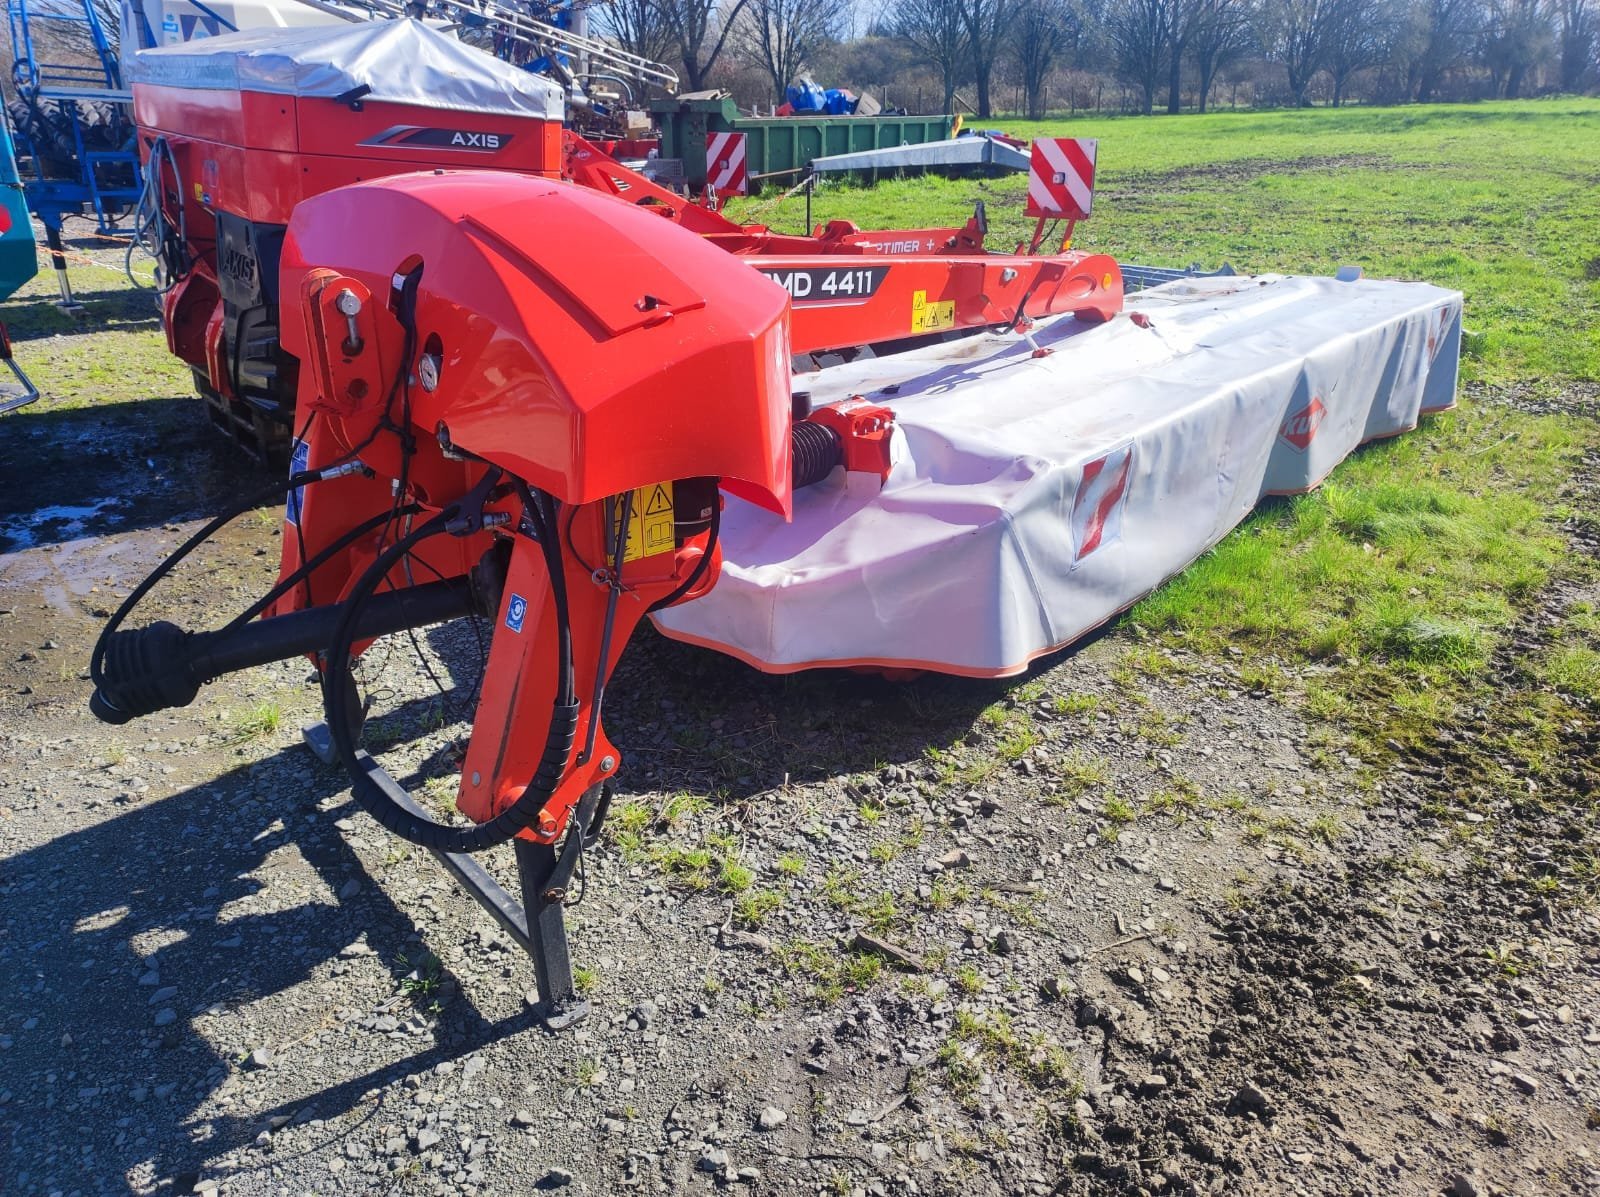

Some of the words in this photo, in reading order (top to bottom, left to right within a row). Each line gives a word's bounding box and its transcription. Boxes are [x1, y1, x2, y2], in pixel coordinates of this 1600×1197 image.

[451, 132, 499, 148] AXIS
[876, 240, 920, 255] PTIMER
[221, 250, 256, 281] AXIS
[762, 272, 812, 297] MD
[821, 270, 873, 295] 4411
